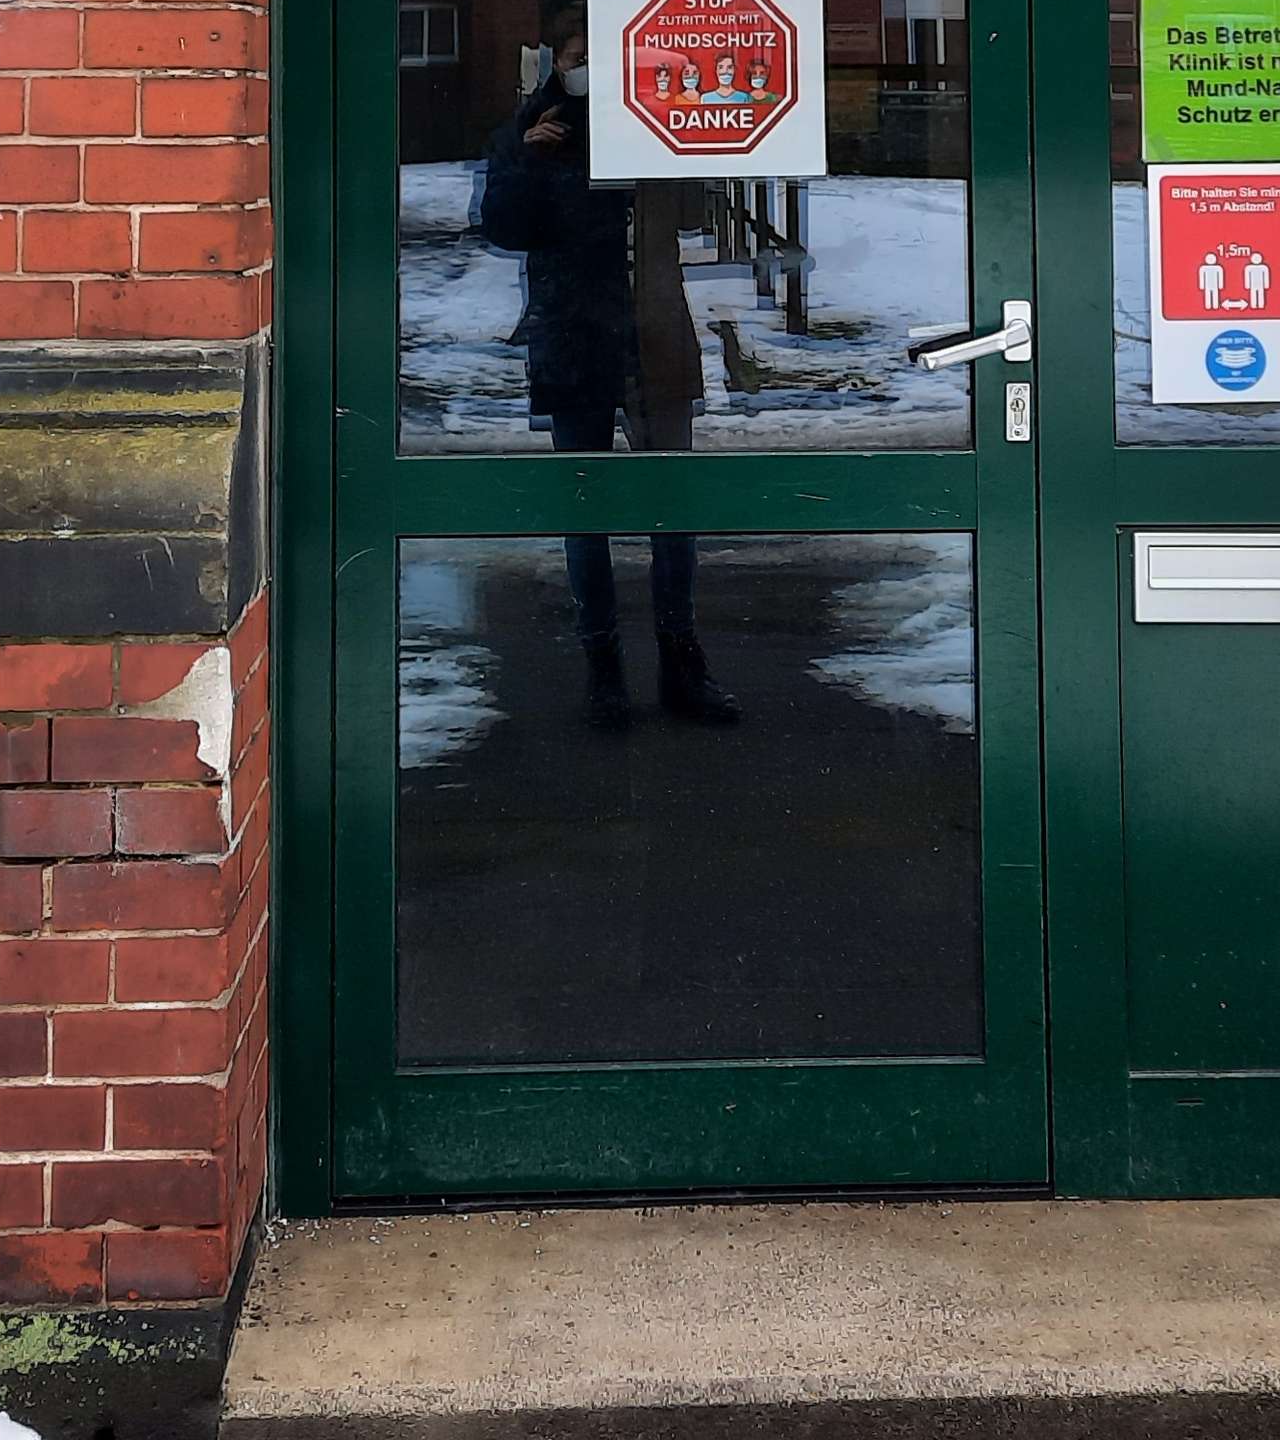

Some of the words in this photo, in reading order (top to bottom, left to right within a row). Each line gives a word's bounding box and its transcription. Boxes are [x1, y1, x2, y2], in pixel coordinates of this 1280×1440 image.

[657, 15, 707, 26] ZUTRITT
[710, 14, 737, 25] NUR
[739, 14, 760, 25] MIT
[645, 32, 776, 48] MUNDSCHUTZ
[1167, 27, 1207, 45] Das
[1169, 53, 1231, 71] Klinik
[1238, 53, 1265, 70] ist
[670, 109, 754, 129] DANKE
[1177, 105, 1252, 124] Schutz
[1171, 188, 1198, 198] Bitte
[1201, 188, 1237, 198] halten
[1239, 187, 1258, 197] Sie
[1190, 202, 1207, 213] 1,5
[1210, 203, 1221, 212] m
[1223, 201, 1275, 212] Abstand!
[1217, 244, 1250, 258] 1,5m
